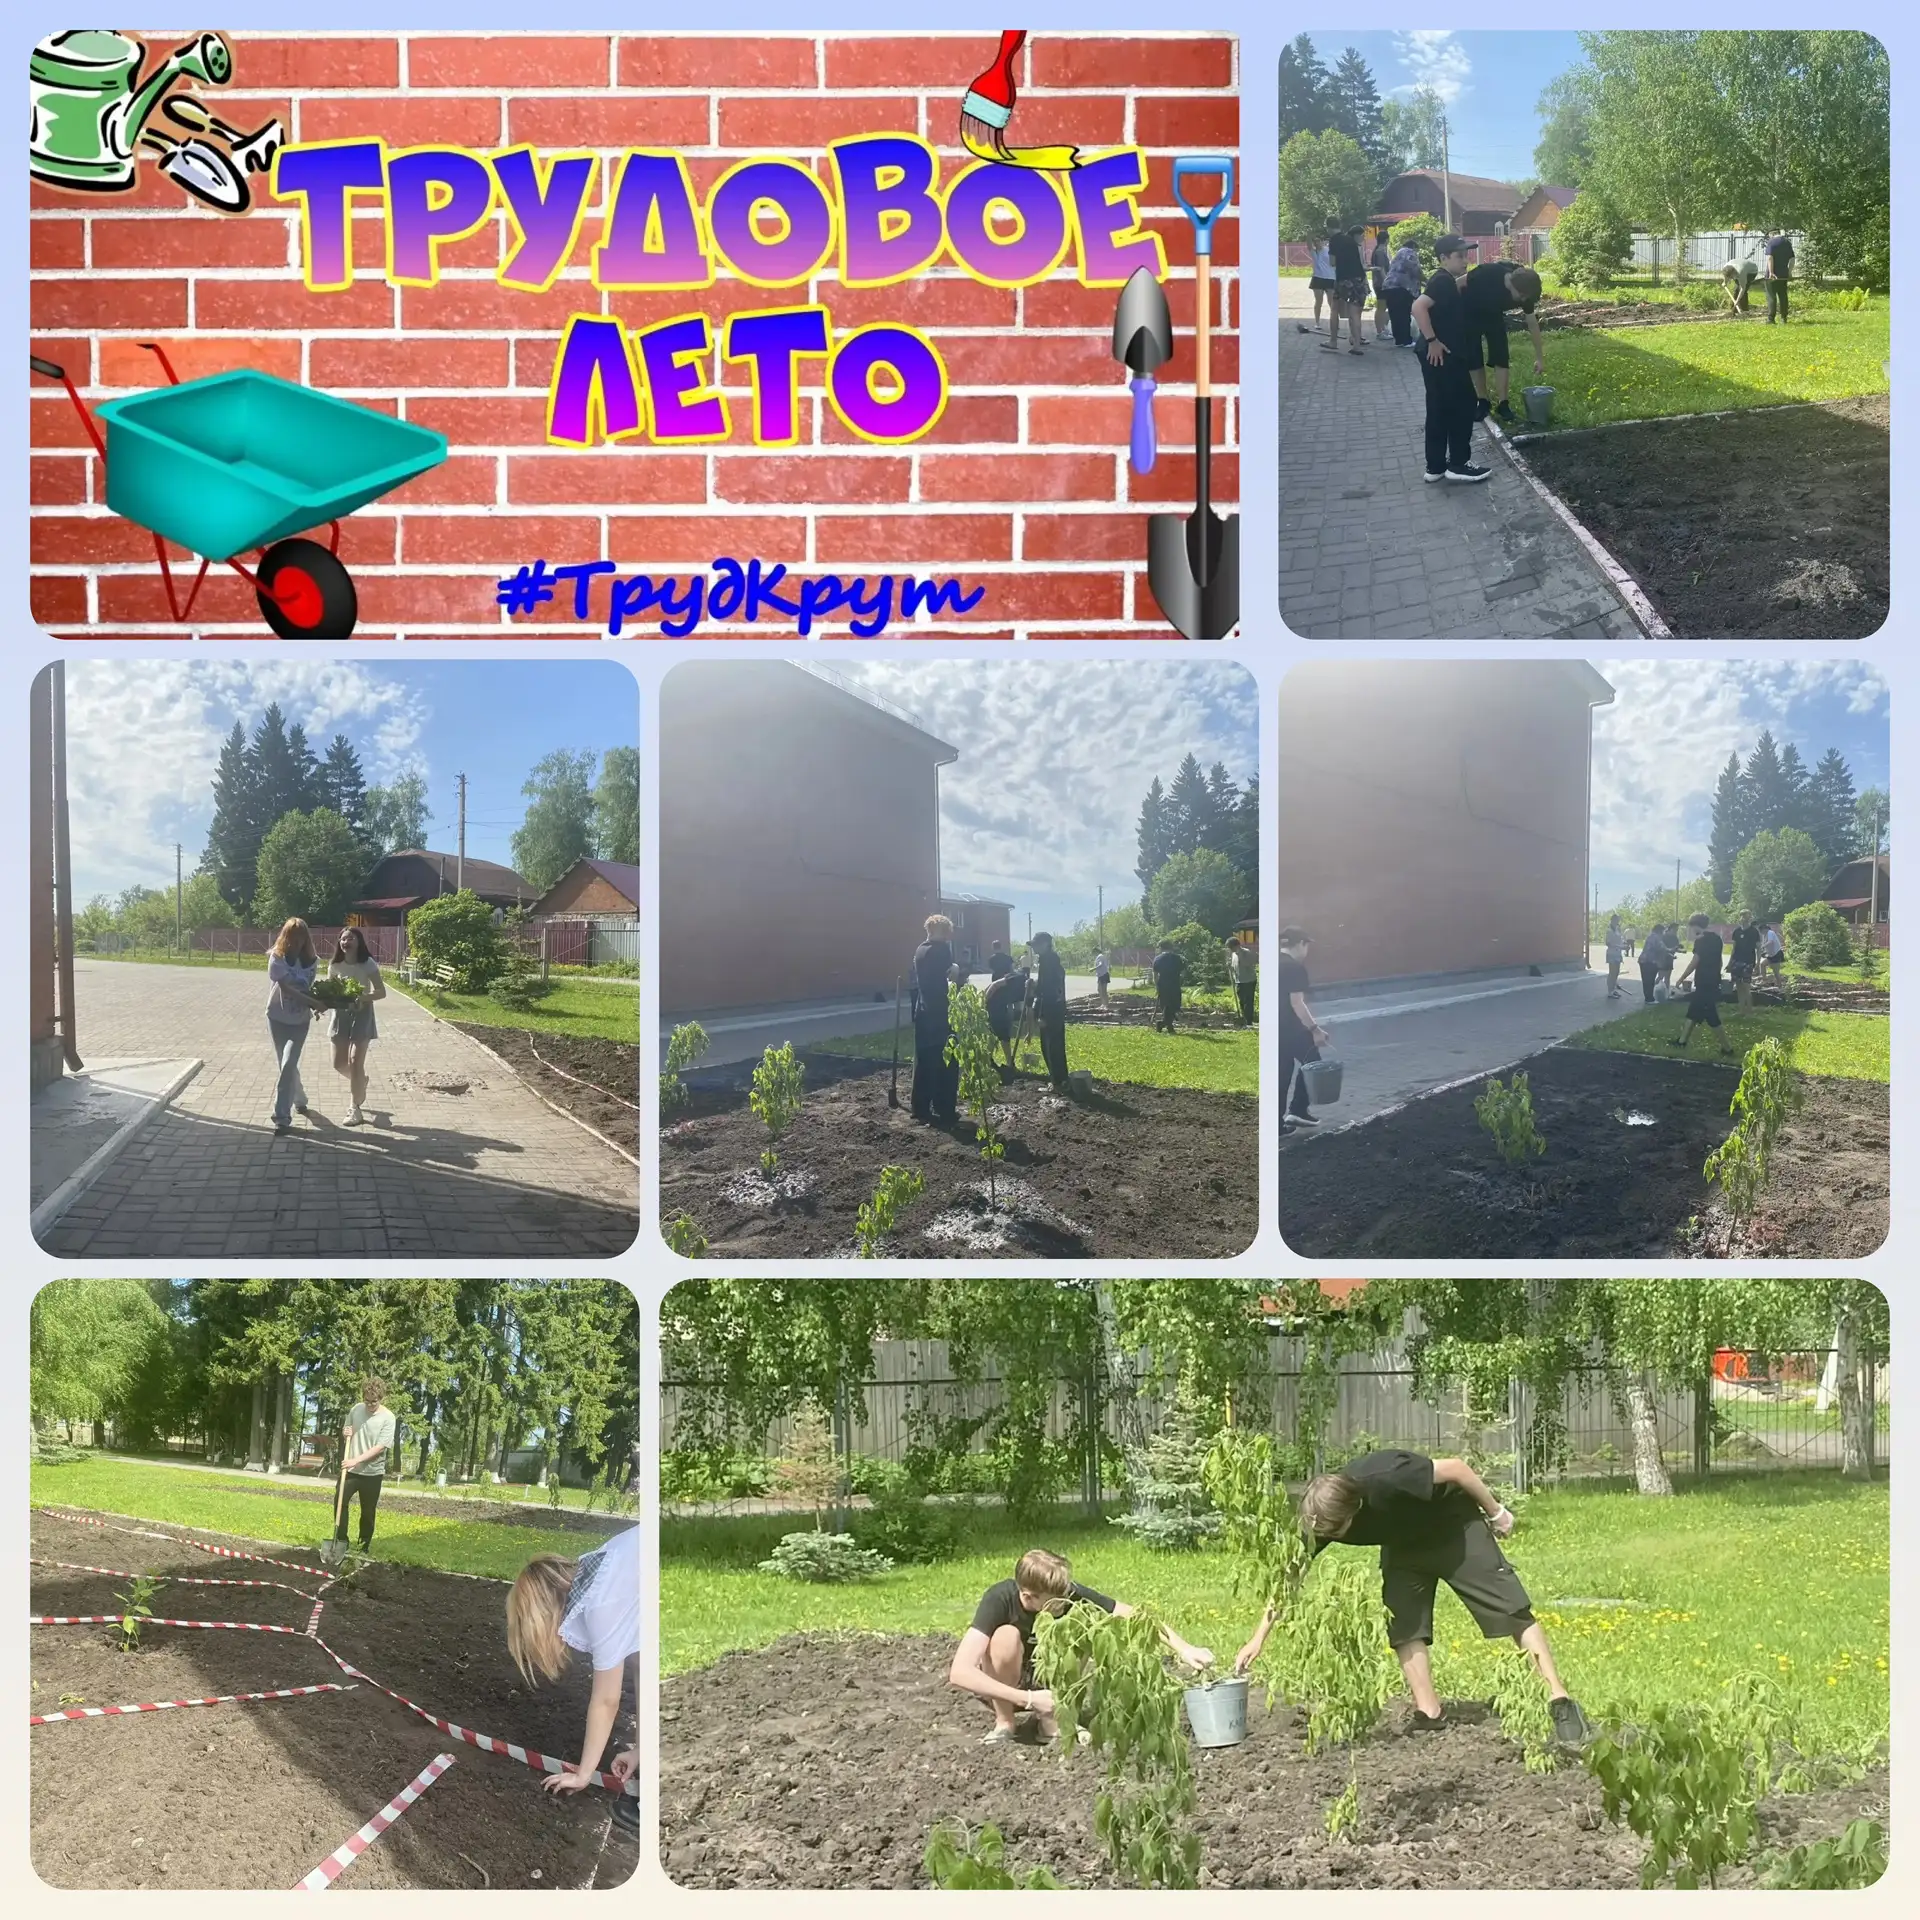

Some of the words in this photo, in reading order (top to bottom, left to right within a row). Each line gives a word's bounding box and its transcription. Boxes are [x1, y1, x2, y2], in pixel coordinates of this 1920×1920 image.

[271, 131, 1168, 293] ТРУДОВОЕ
[547, 305, 949, 447] ЛЕТО
[497, 557, 986, 637] #ТрудКрут
